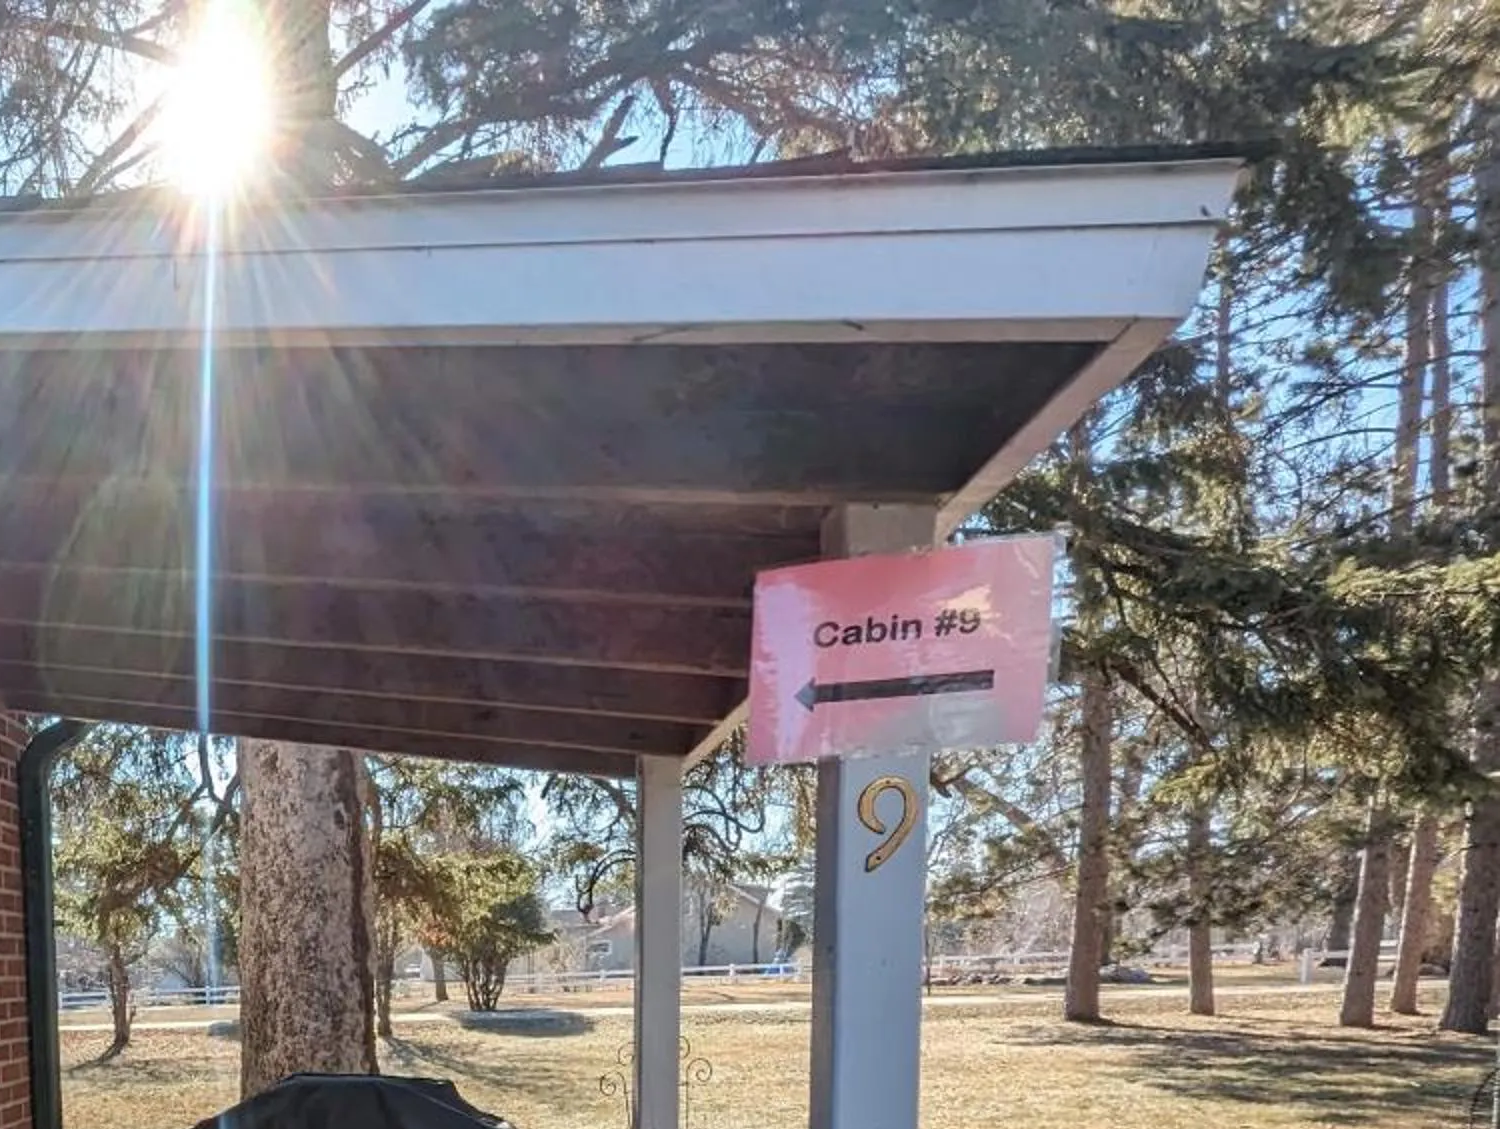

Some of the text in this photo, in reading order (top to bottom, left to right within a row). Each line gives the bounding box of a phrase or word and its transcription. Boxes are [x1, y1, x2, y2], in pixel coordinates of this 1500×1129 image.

[814, 608, 981, 648] Cabin #9
[857, 775, 918, 873] 9
